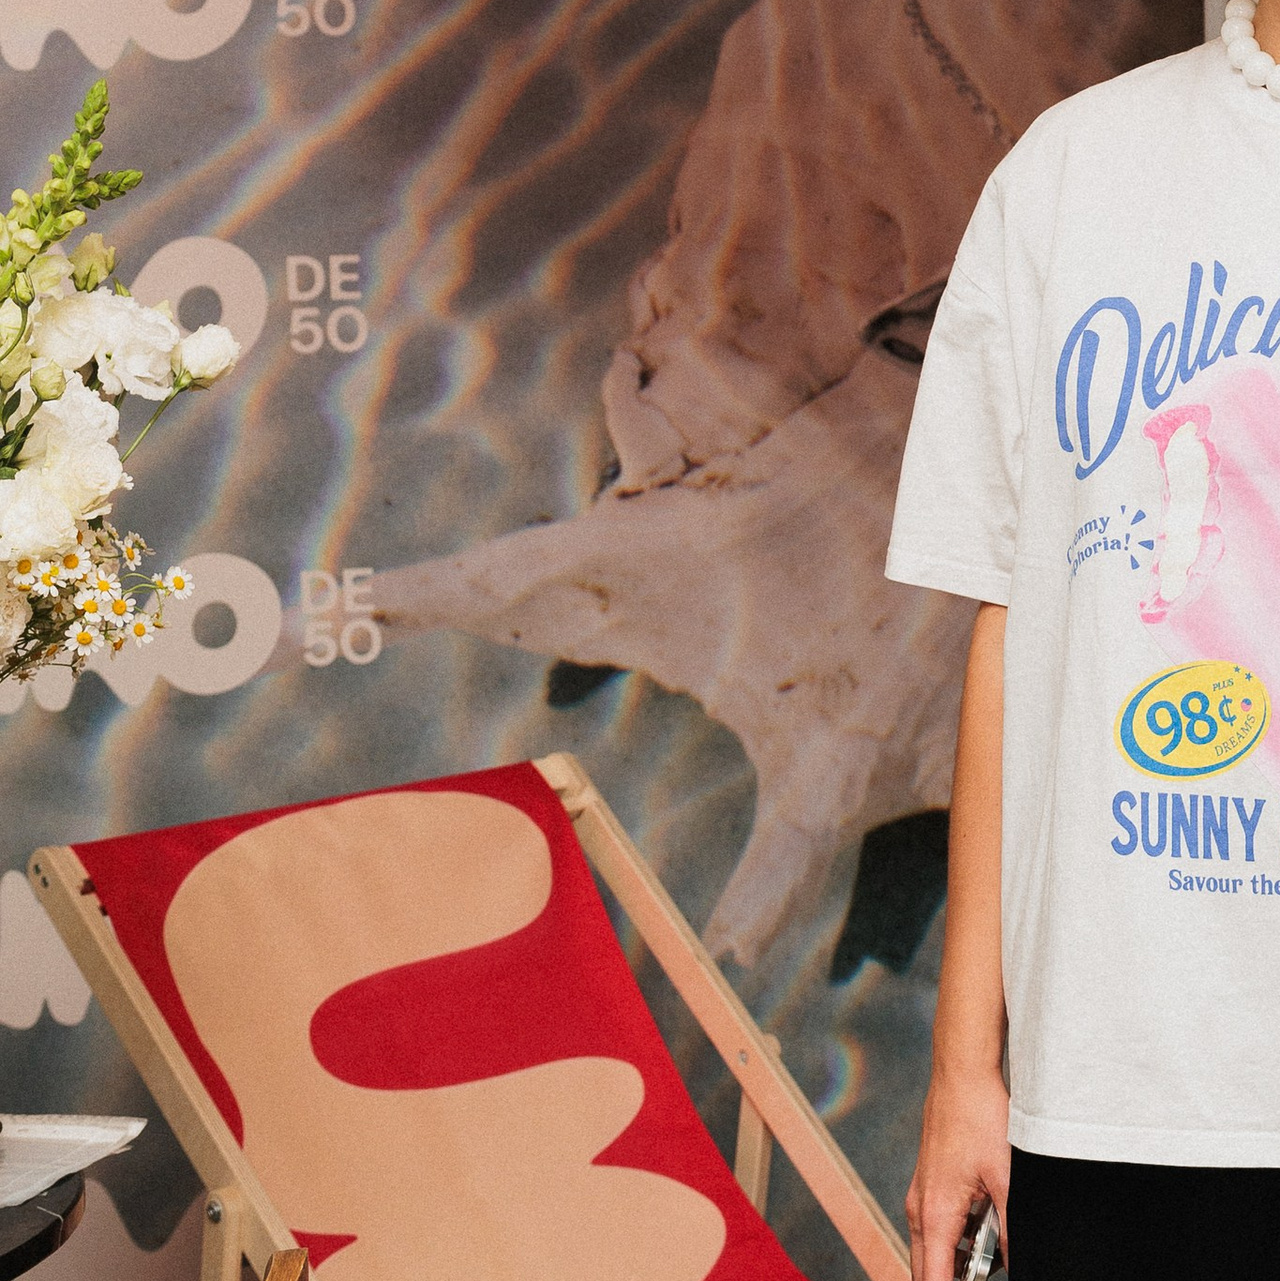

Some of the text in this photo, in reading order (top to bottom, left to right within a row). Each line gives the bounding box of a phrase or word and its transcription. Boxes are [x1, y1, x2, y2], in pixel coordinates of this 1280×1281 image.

[285, 255, 362, 302] DE
[289, 308, 368, 355] 50
[301, 568, 375, 615] DE
[303, 619, 382, 666] 50
[1212, 678, 1235, 692] PLUS
[1214, 713, 1257, 758] DREAMS
[1110, 789, 1266, 863] SUNNY
[1168, 868, 1244, 895] Savour
